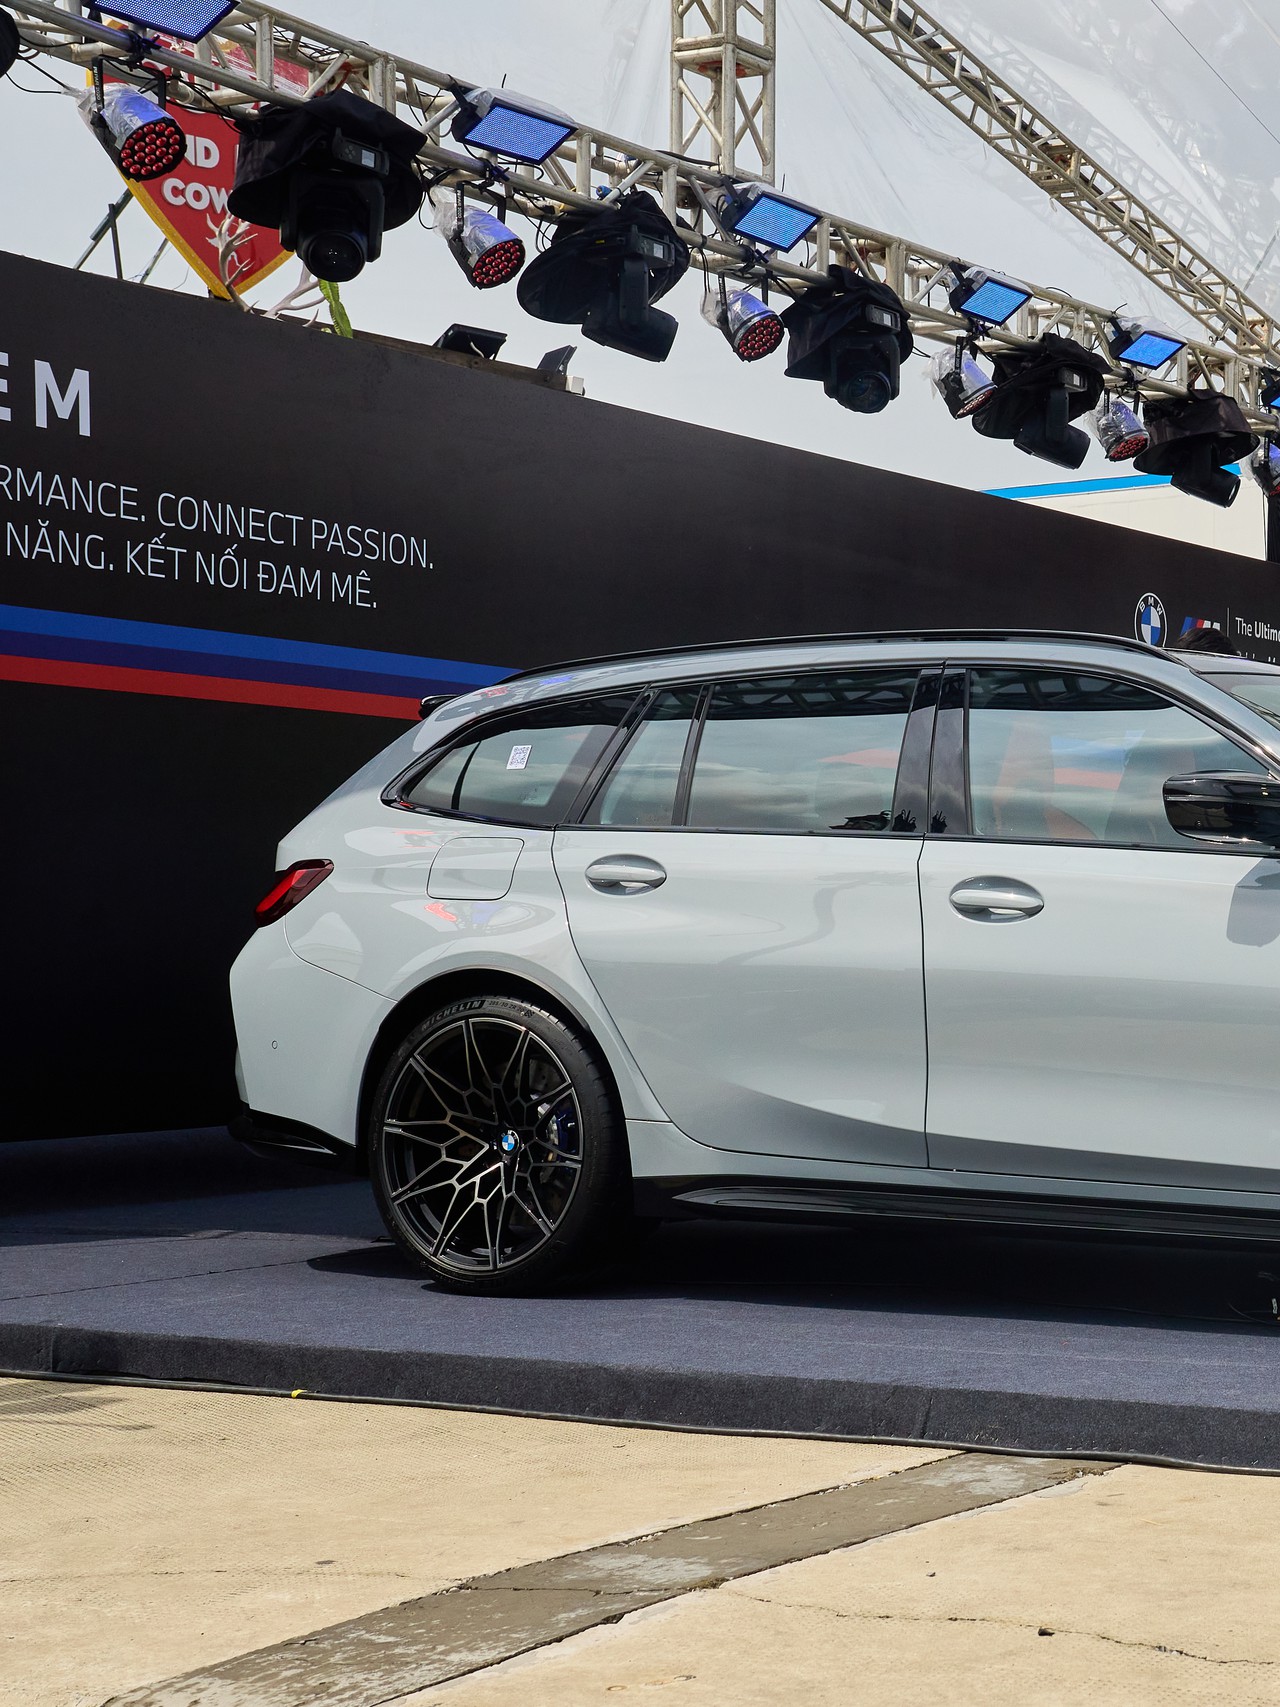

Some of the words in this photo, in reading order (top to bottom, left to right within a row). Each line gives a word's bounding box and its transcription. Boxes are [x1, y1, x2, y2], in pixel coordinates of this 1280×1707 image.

[157, 492, 304, 546] CONNECT
[311, 518, 434, 569] PASSION.
[6, 519, 114, 571] NĂNG.
[127, 532, 187, 580] KẾT
[196, 543, 248, 590] NỐI
[257, 561, 322, 600] ĐAM
[331, 569, 378, 609] MÊ.
[1139, 596, 1163, 616] BMW
[1235, 616, 1253, 637] The
[421, 1000, 482, 1031] MICHELIN
